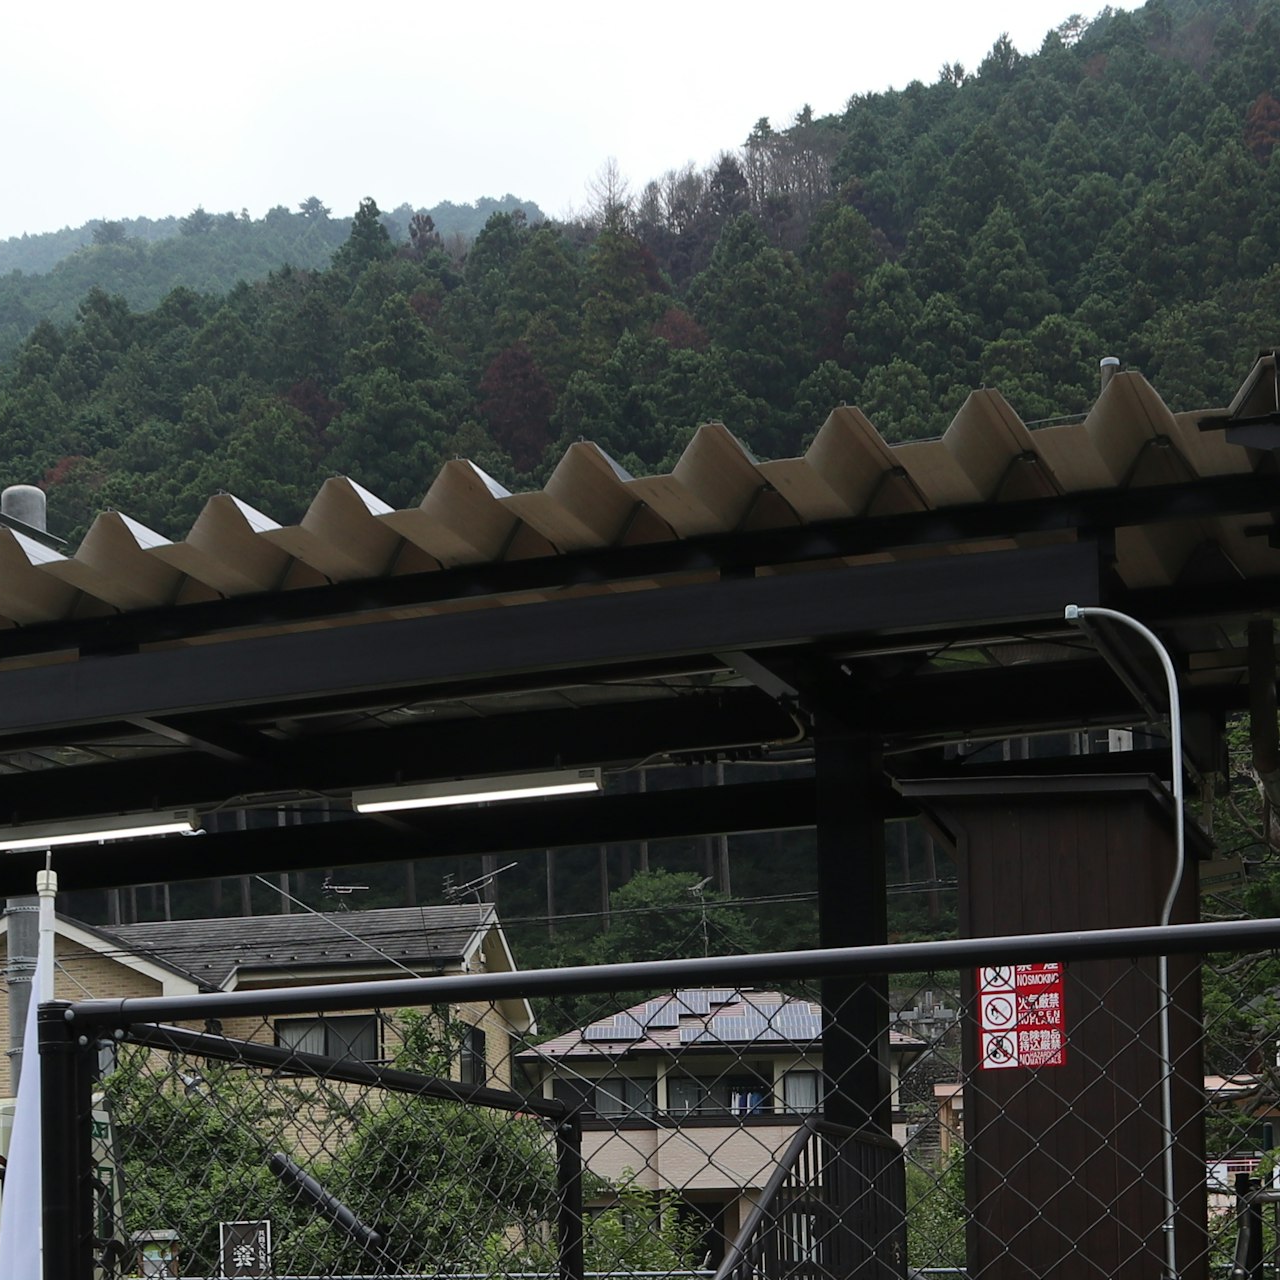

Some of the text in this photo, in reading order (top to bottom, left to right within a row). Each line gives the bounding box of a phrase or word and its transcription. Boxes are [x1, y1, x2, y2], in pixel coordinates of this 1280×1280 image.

[1017, 973, 1060, 986] NO SMOKING
[1018, 993, 1060, 1011] 火気厳禁
